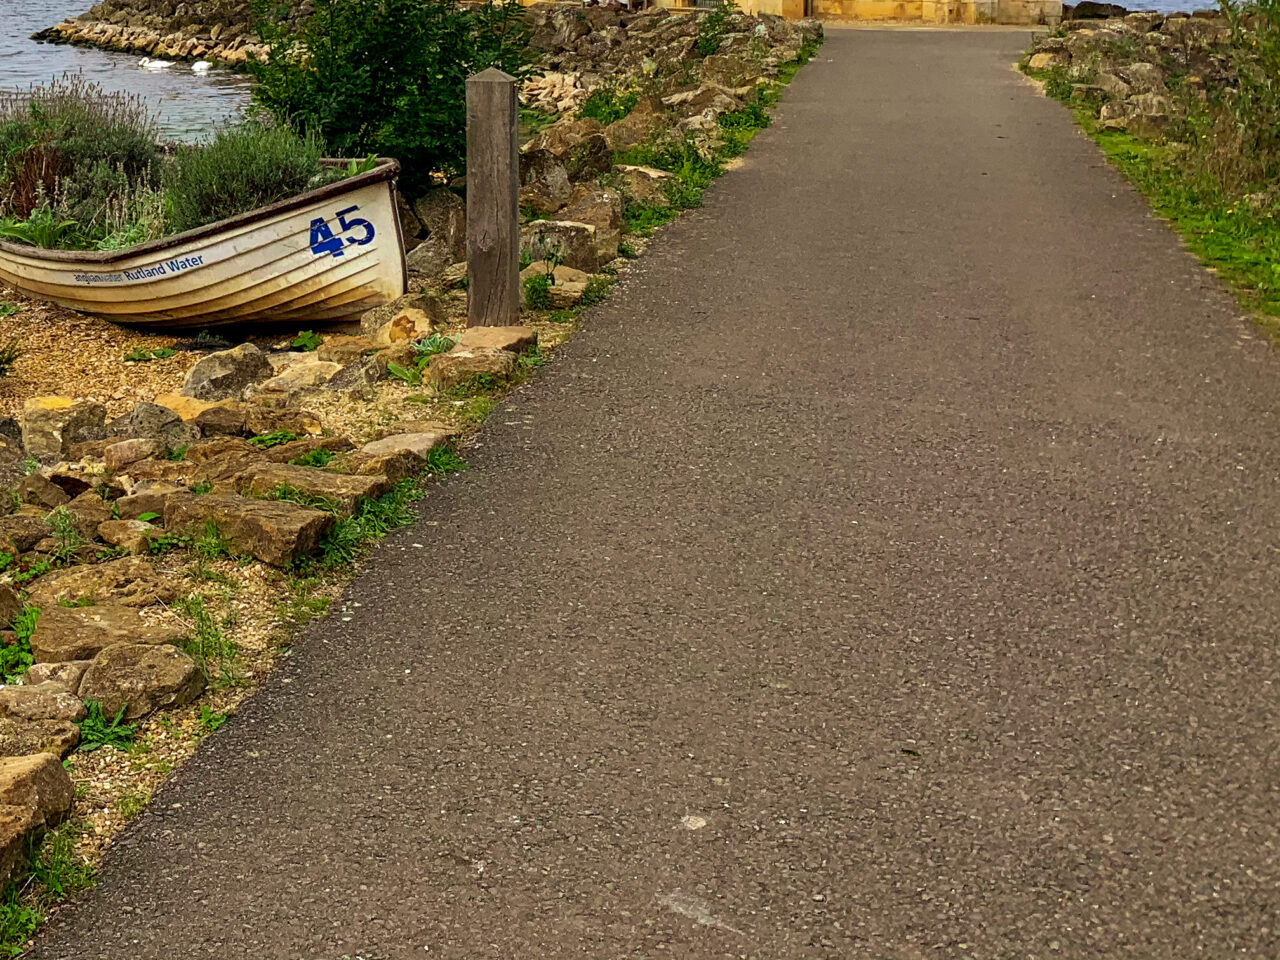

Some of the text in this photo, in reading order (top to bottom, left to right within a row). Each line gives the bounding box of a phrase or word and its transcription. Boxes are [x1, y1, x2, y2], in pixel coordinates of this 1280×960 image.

[309, 205, 375, 257] 45
[123, 265, 166, 281] Rutland
[166, 255, 204, 273] Water
